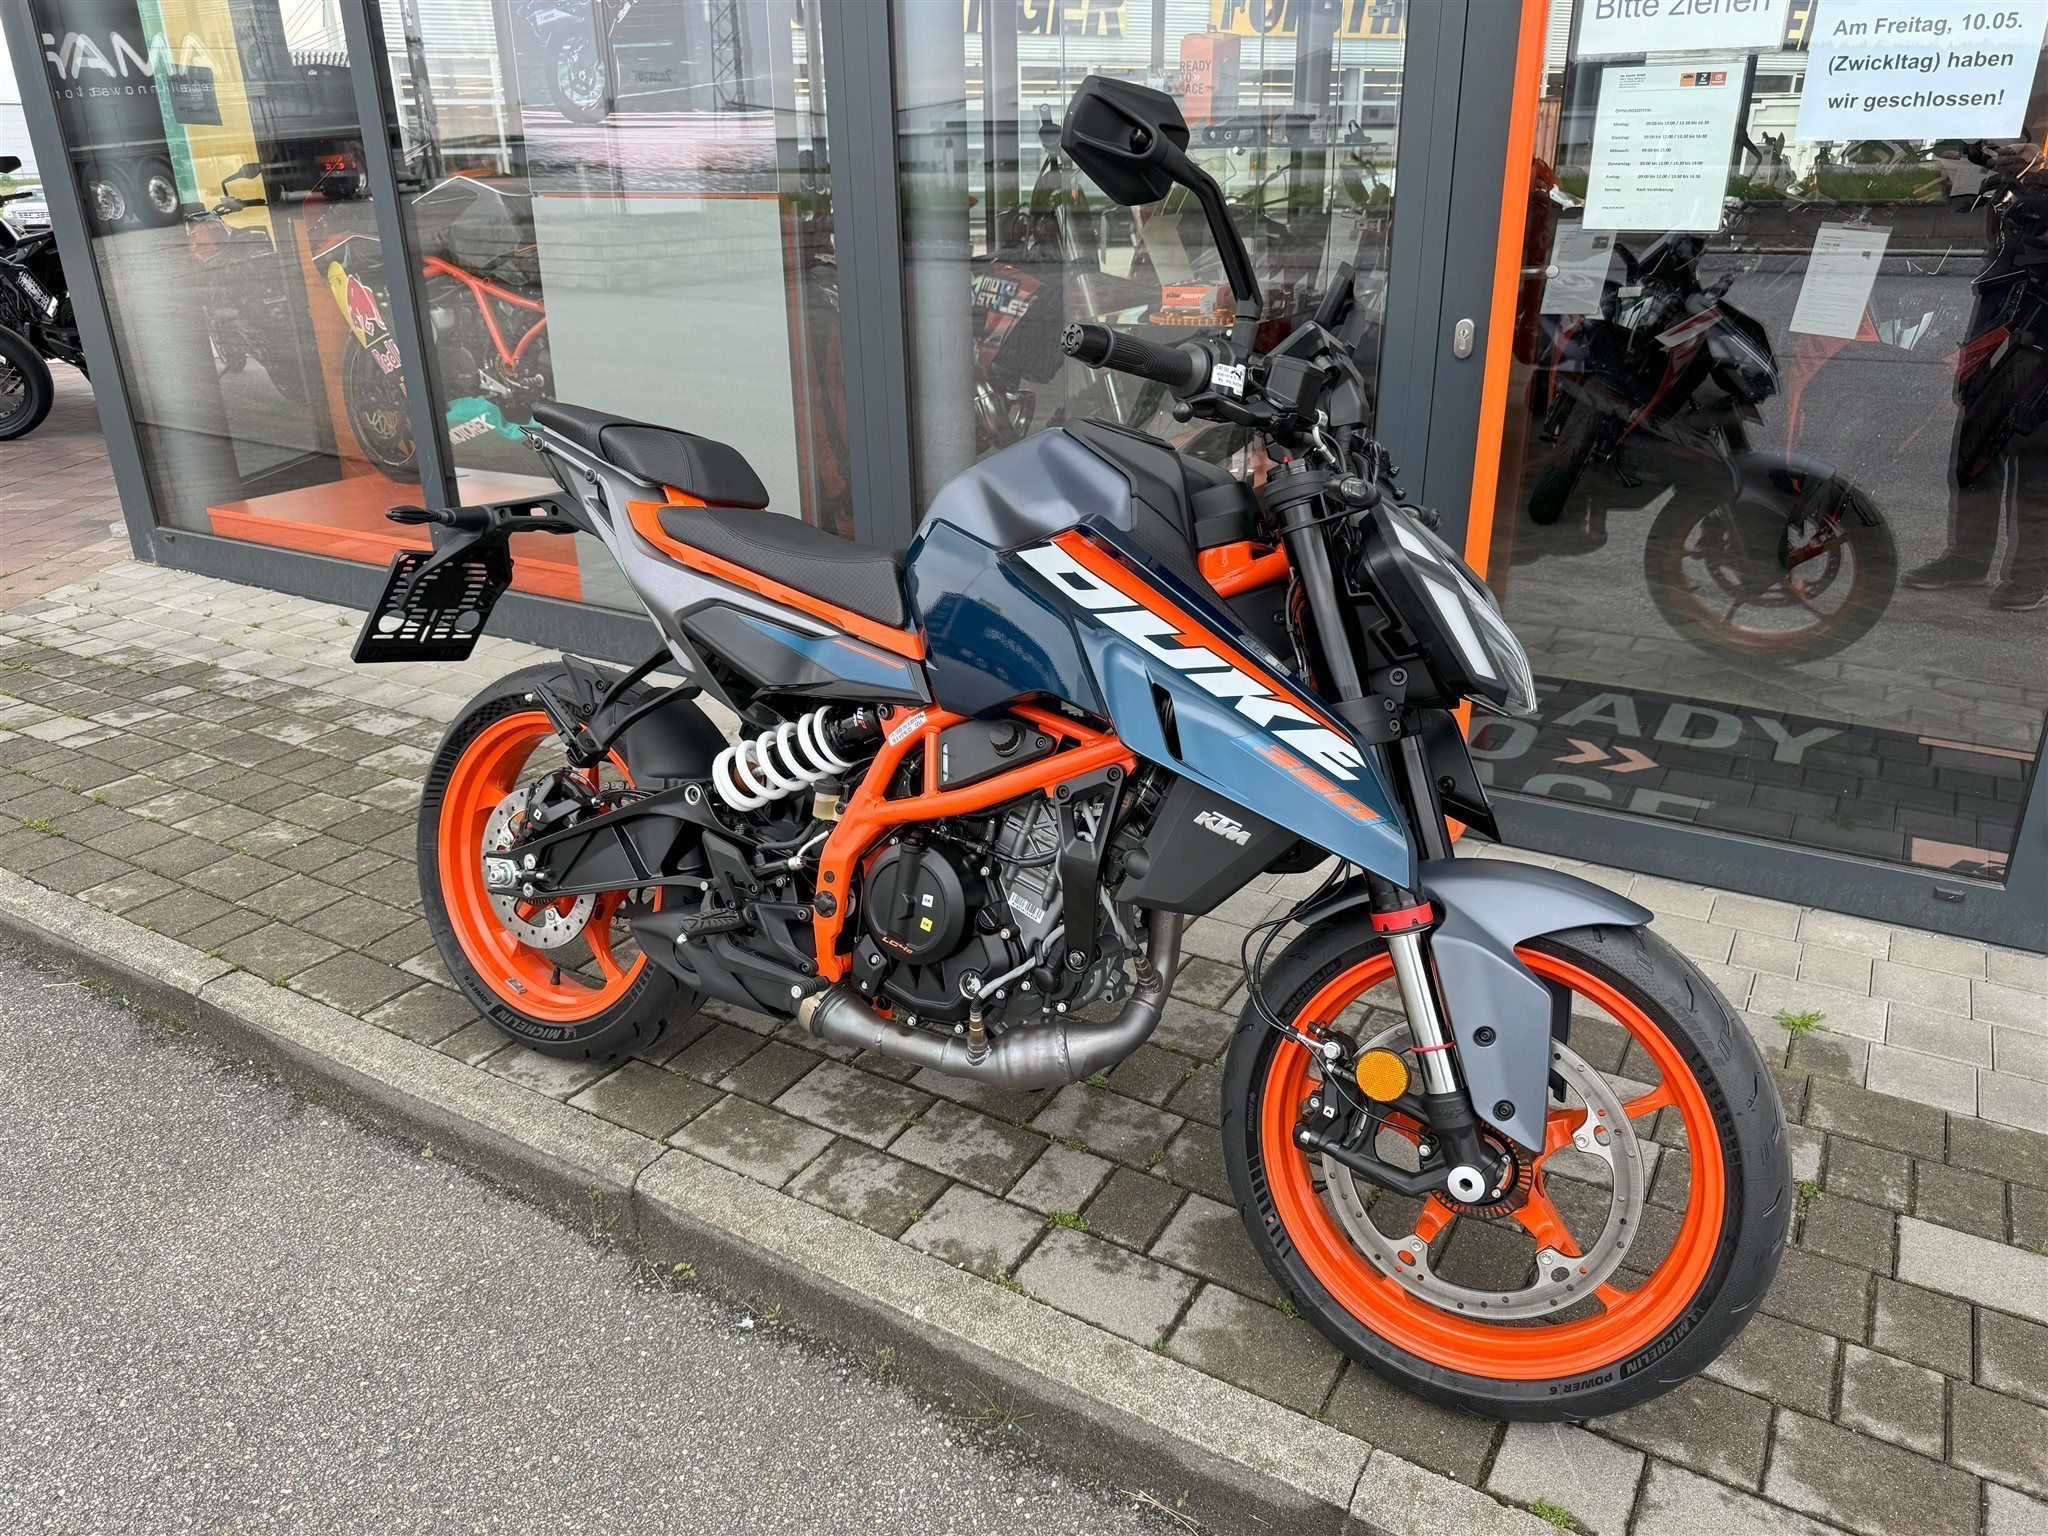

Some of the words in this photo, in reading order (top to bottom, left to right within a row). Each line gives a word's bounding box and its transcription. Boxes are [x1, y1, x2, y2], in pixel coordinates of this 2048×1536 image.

[1595, 0, 1660, 20] Bitte
[1832, 19, 1868, 36] Am
[1873, 16, 1953, 36] Freitag,
[1961, 12, 2023, 31] 10.05.
[1179, 59, 1212, 72] READY
[1828, 51, 1941, 76] (Zwickltag)
[1947, 50, 2014, 68] haben
[1179, 71, 1192, 83] TO
[1184, 83, 1204, 94] ACE
[1828, 93, 1858, 109] wir
[1863, 89, 2005, 112] geschlossen!
[1016, 540, 1367, 782] DUKE
[1192, 810, 1252, 847] KTM
[496, 1009, 562, 1040] MICHELIN
[1626, 1320, 1691, 1375] MICHELIN
[1549, 1387, 1558, 1395] 6
[1563, 1372, 1613, 1393] POWER
